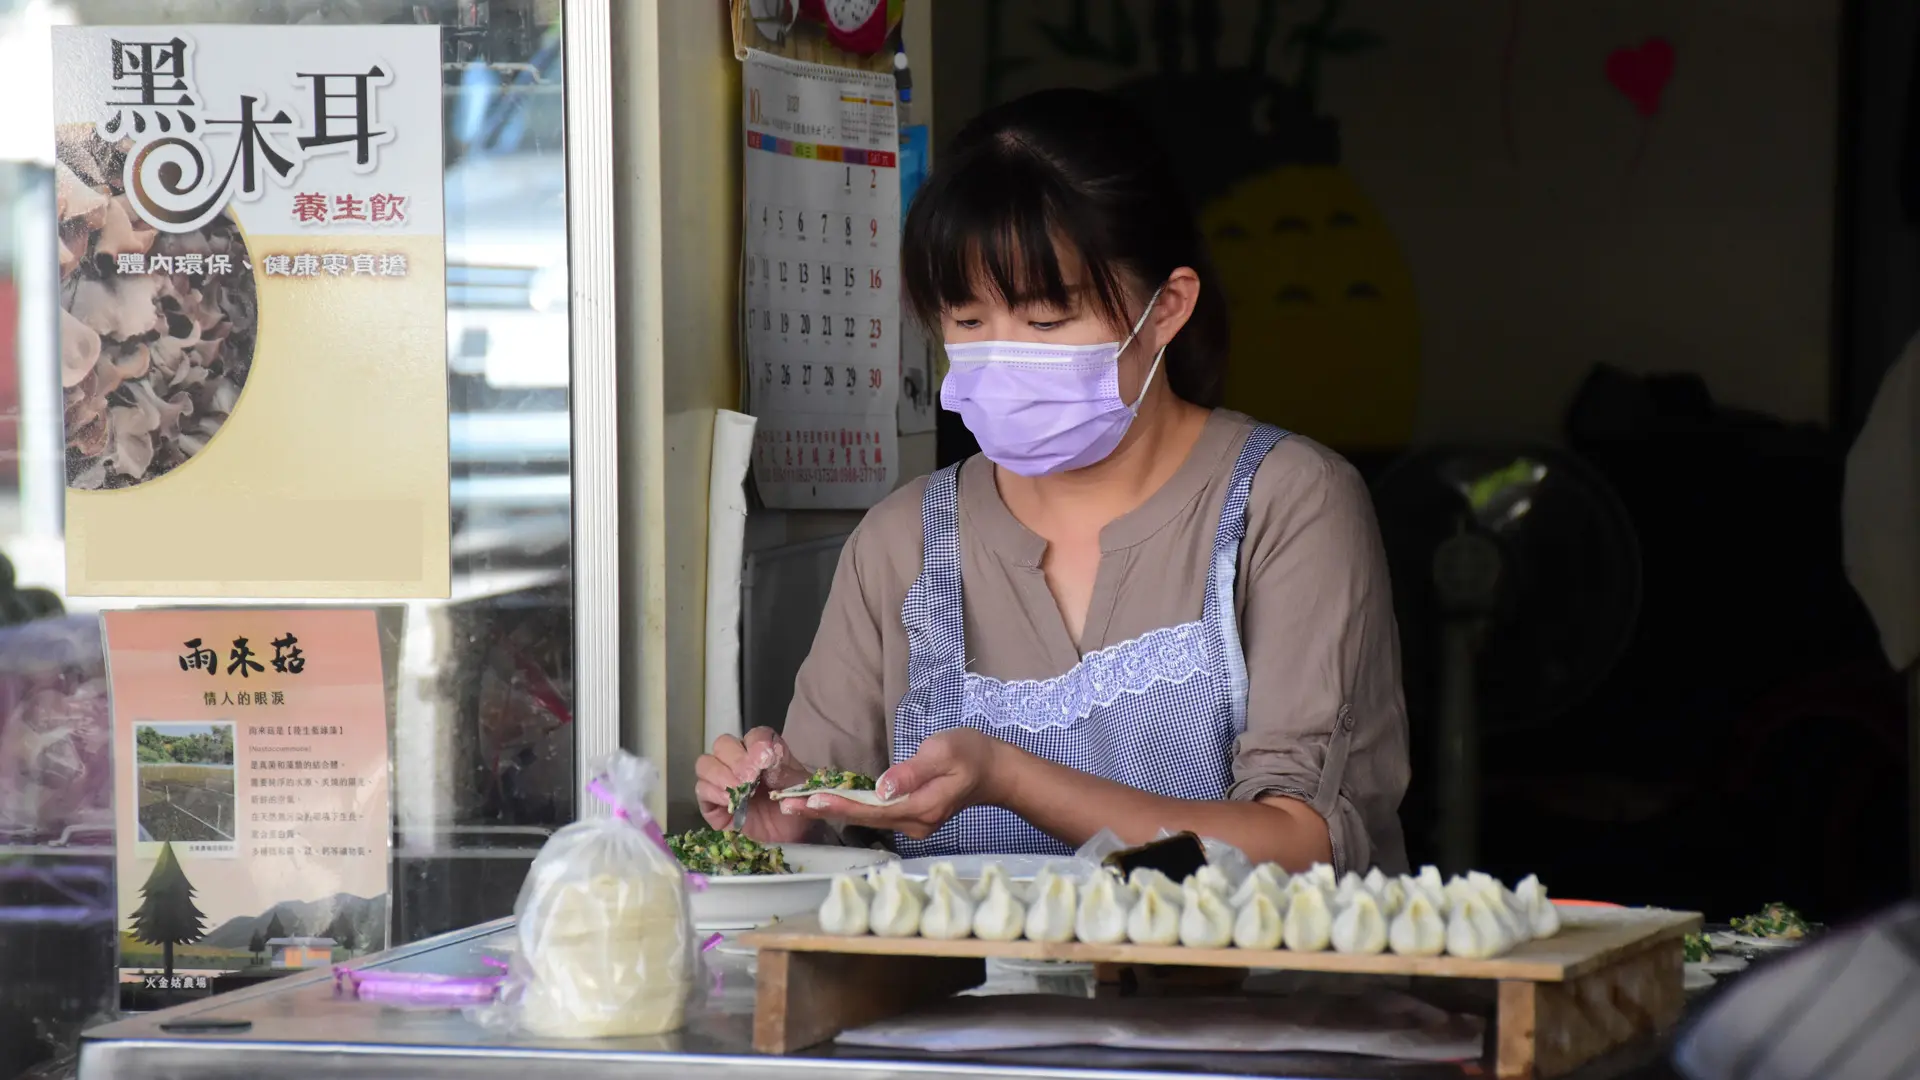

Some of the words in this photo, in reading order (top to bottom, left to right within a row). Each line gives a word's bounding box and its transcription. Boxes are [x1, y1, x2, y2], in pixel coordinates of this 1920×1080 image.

[104, 37, 388, 223] 黑木耳
[870, 168, 877, 189] 2
[293, 193, 405, 222] 養生飲
[778, 210, 784, 231] 5
[797, 211, 804, 232] 6
[821, 213, 828, 234] 7
[845, 216, 852, 237] 8
[870, 218, 878, 239] 9
[779, 260, 788, 282] 12
[799, 262, 809, 284] 13
[821, 264, 832, 285] 14
[844, 267, 855, 288] 15
[869, 269, 882, 289] 16
[780, 312, 789, 333] 19
[800, 314, 811, 335] 20
[822, 315, 832, 336] 21
[844, 317, 855, 338] 22
[869, 318, 882, 339] 23
[802, 364, 812, 386] 27
[824, 365, 834, 387] 28
[846, 366, 857, 388] 29
[868, 368, 882, 389] 30
[178, 632, 306, 678] 雨來菇
[203, 691, 285, 706] 情人的眼淚
[145, 976, 207, 989] 火金姑農場
